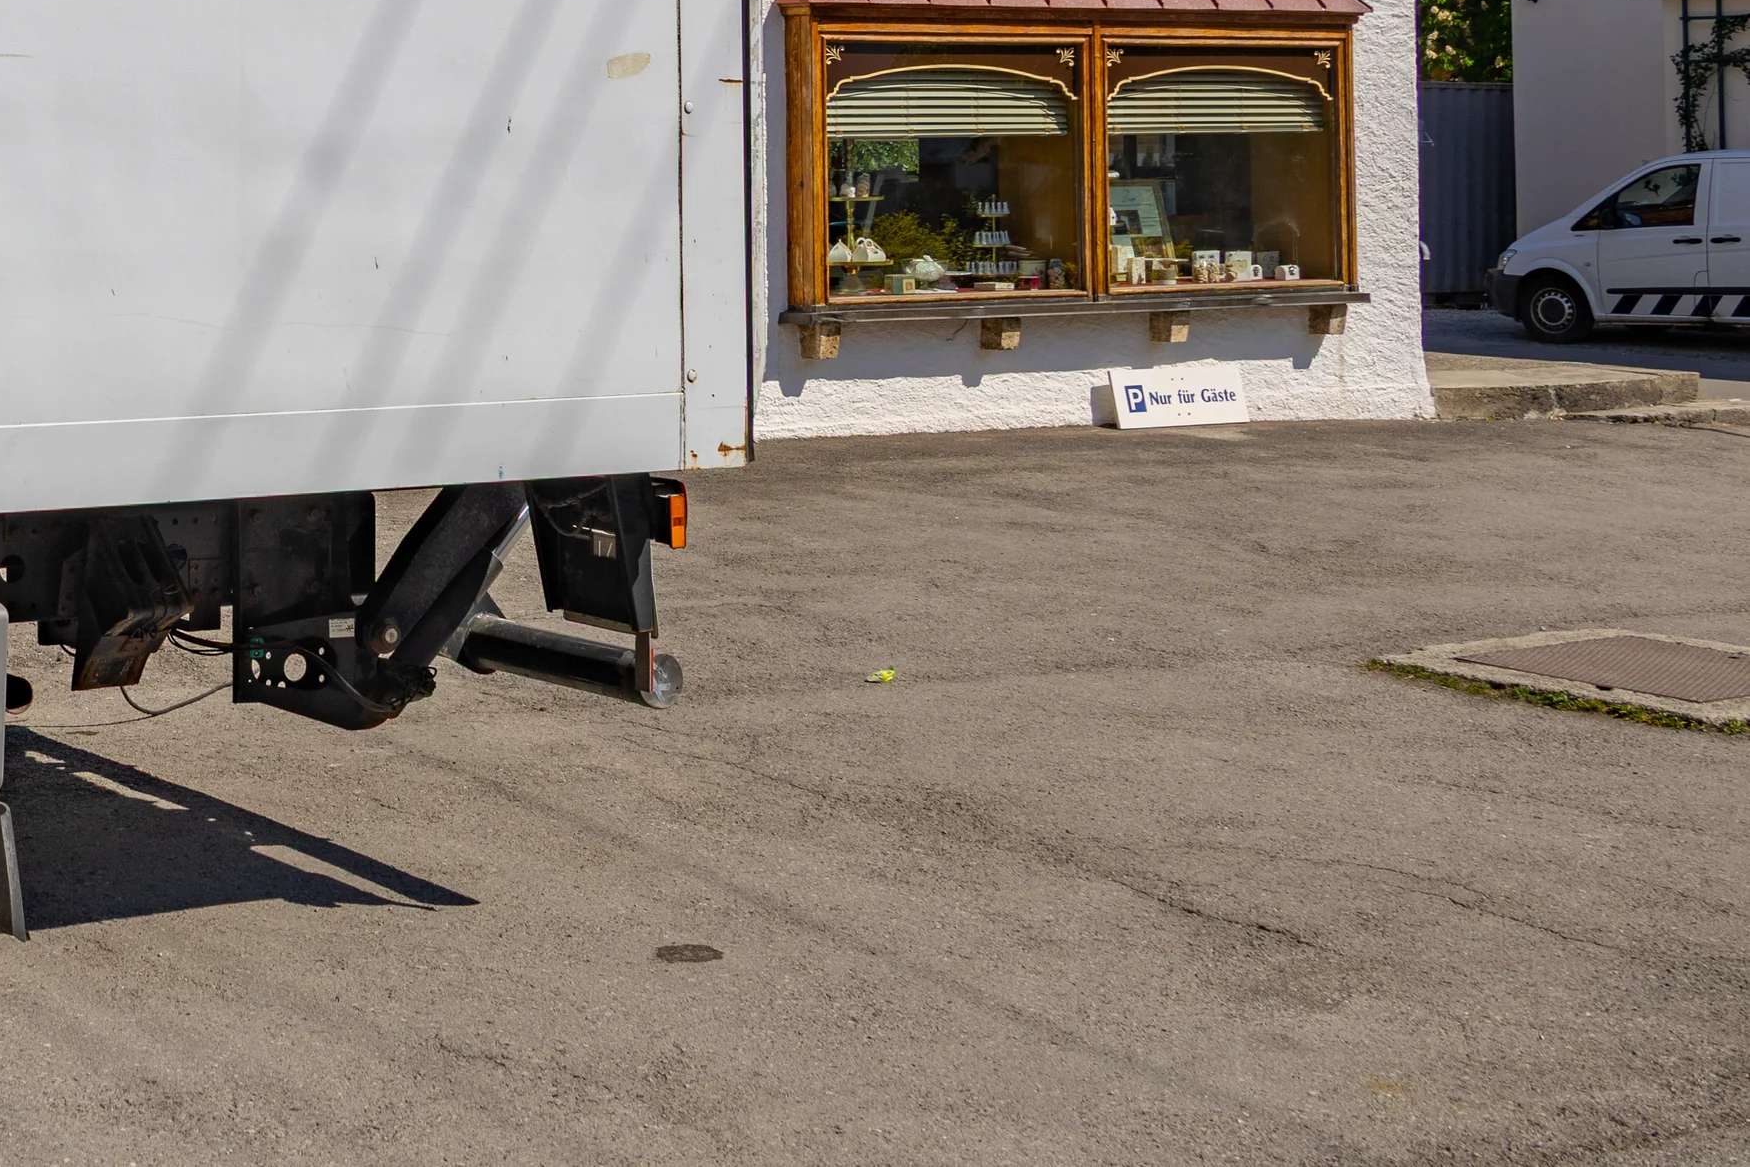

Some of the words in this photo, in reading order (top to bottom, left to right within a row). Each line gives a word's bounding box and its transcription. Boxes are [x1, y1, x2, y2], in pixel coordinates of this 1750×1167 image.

[1127, 386, 1144, 412] P
[1149, 391, 1172, 406] Nur
[1177, 389, 1196, 404] für
[1200, 387, 1237, 403] Gäste
